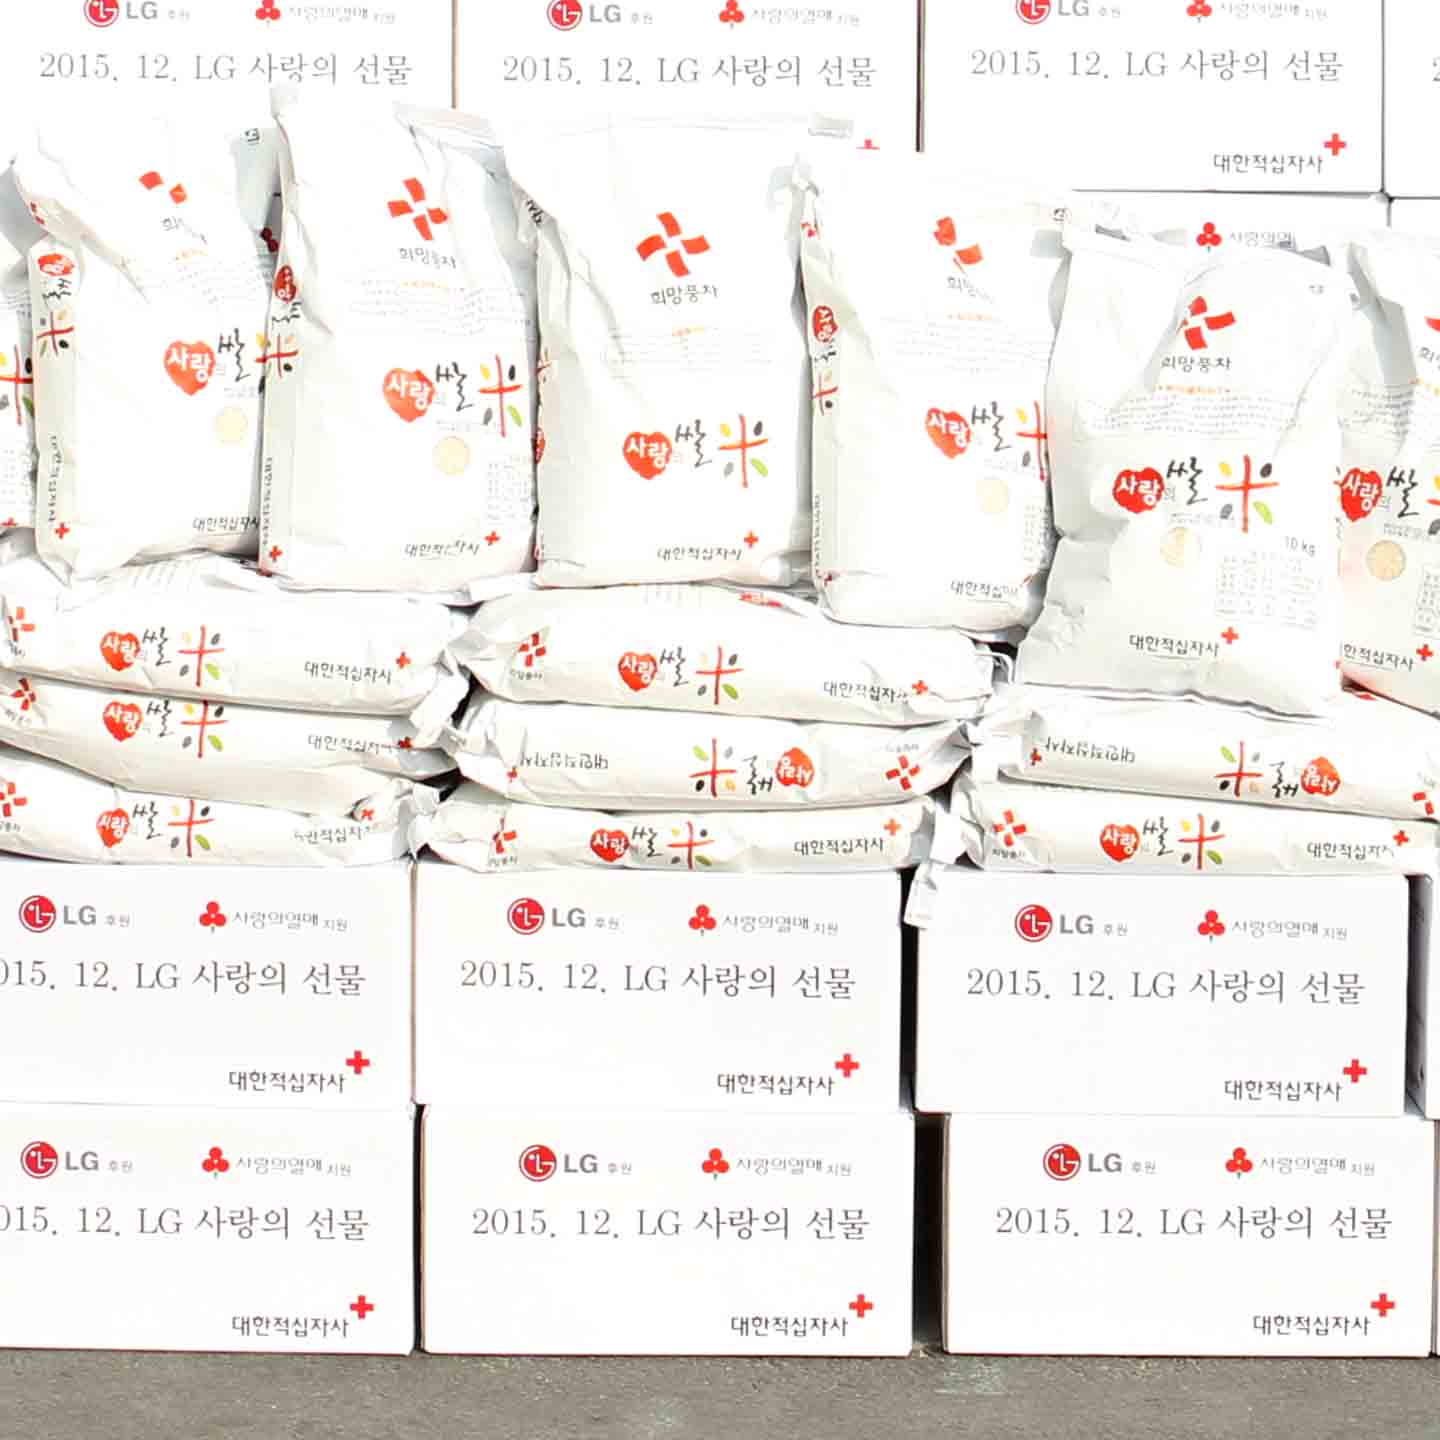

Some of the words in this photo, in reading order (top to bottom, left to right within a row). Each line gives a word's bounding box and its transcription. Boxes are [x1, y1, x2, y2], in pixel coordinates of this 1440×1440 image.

[40, 53, 117, 81] 2015.
[139, 54, 176, 82] 12.
[195, 56, 235, 80] LG
[250, 53, 336, 85] 사랑의
[354, 54, 412, 85] 선물
[504, 56, 581, 85] 2015.
[603, 57, 640, 85] 12.
[658, 58, 698, 82] LG
[714, 56, 800, 87] 사랑의
[818, 56, 876, 87] 선물
[971, 50, 1048, 78] 2015.
[1072, 52, 1108, 79] 12.
[1127, 52, 1168, 76] LG
[1181, 49, 1267, 80] 사랑의
[1286, 50, 1343, 81] 선물
[1214, 154, 1323, 174] 대한적십자사
[651, 285, 717, 304] 희망풍차
[1161, 356, 1230, 373] 희망풍차
[675, 419, 712, 468] 쌀
[1166, 457, 1207, 505] 쌀
[657, 547, 742, 560] 대한적십자사
[1130, 635, 1219, 659] 대한적십자사
[794, 838, 883, 856] 대한적십자사
[1060, 914, 1093, 934] LG
[76, 962, 117, 991] 12.
[136, 963, 179, 989] LG
[192, 961, 285, 995] 사랑의
[304, 963, 365, 996] 선물
[461, 960, 543, 991] 2015.
[565, 964, 606, 993] 12.
[624, 965, 667, 991] LG
[683, 964, 774, 998] 사랑의
[792, 966, 856, 999] 선물
[968, 968, 1050, 999] 2015.
[1072, 971, 1113, 1000] 12.
[1133, 972, 1176, 998] LG
[1190, 970, 1283, 1003] 사랑의
[1302, 971, 1365, 1004] 선물
[1225, 1080, 1342, 1102] 대한적십자사
[66, 1151, 99, 1171] LG
[472, 1209, 556, 1238] 2015.
[578, 1210, 618, 1238] 12.
[638, 1210, 680, 1235] LG
[696, 1207, 788, 1240] 사랑의
[808, 1208, 869, 1240] 선물
[731, 1316, 848, 1337] 대한적십자사
